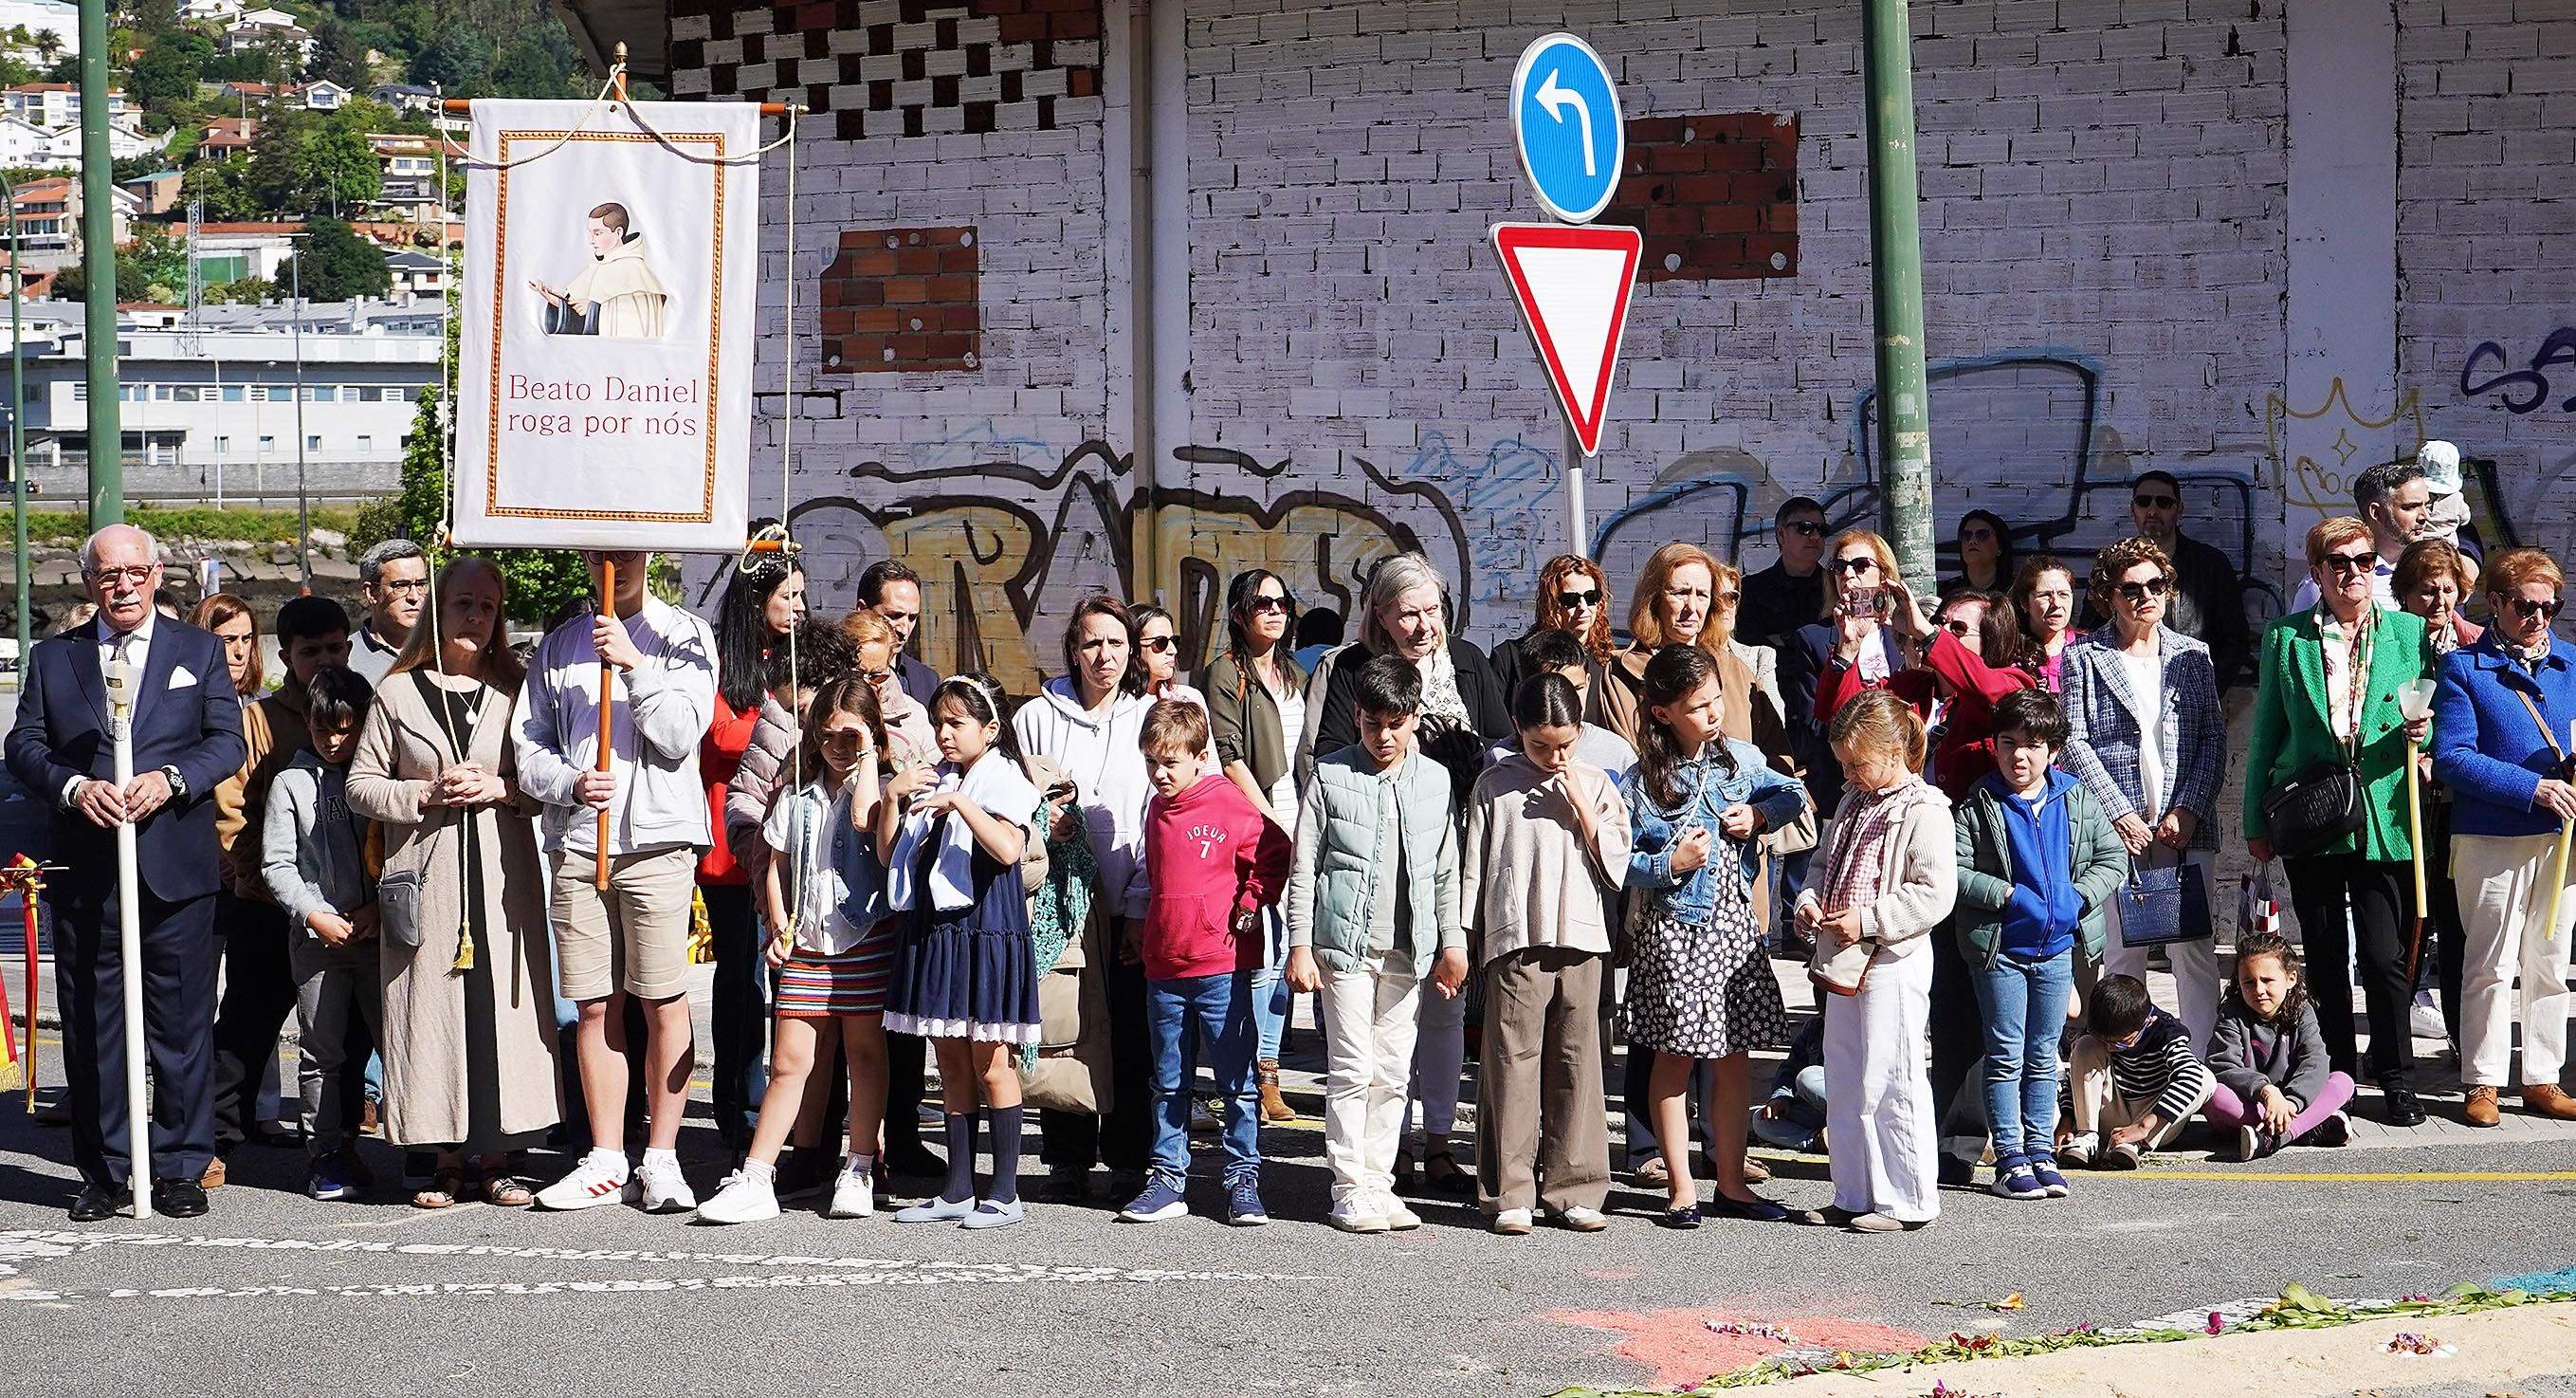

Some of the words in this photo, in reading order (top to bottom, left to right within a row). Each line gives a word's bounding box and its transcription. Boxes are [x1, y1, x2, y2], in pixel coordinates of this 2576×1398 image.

[509, 375, 591, 400] Beato
[605, 376, 698, 403] Daniel
[507, 414, 572, 436] roga
[584, 415, 632, 436] por
[646, 411, 696, 435] nós
[1199, 839, 1212, 859] 7
